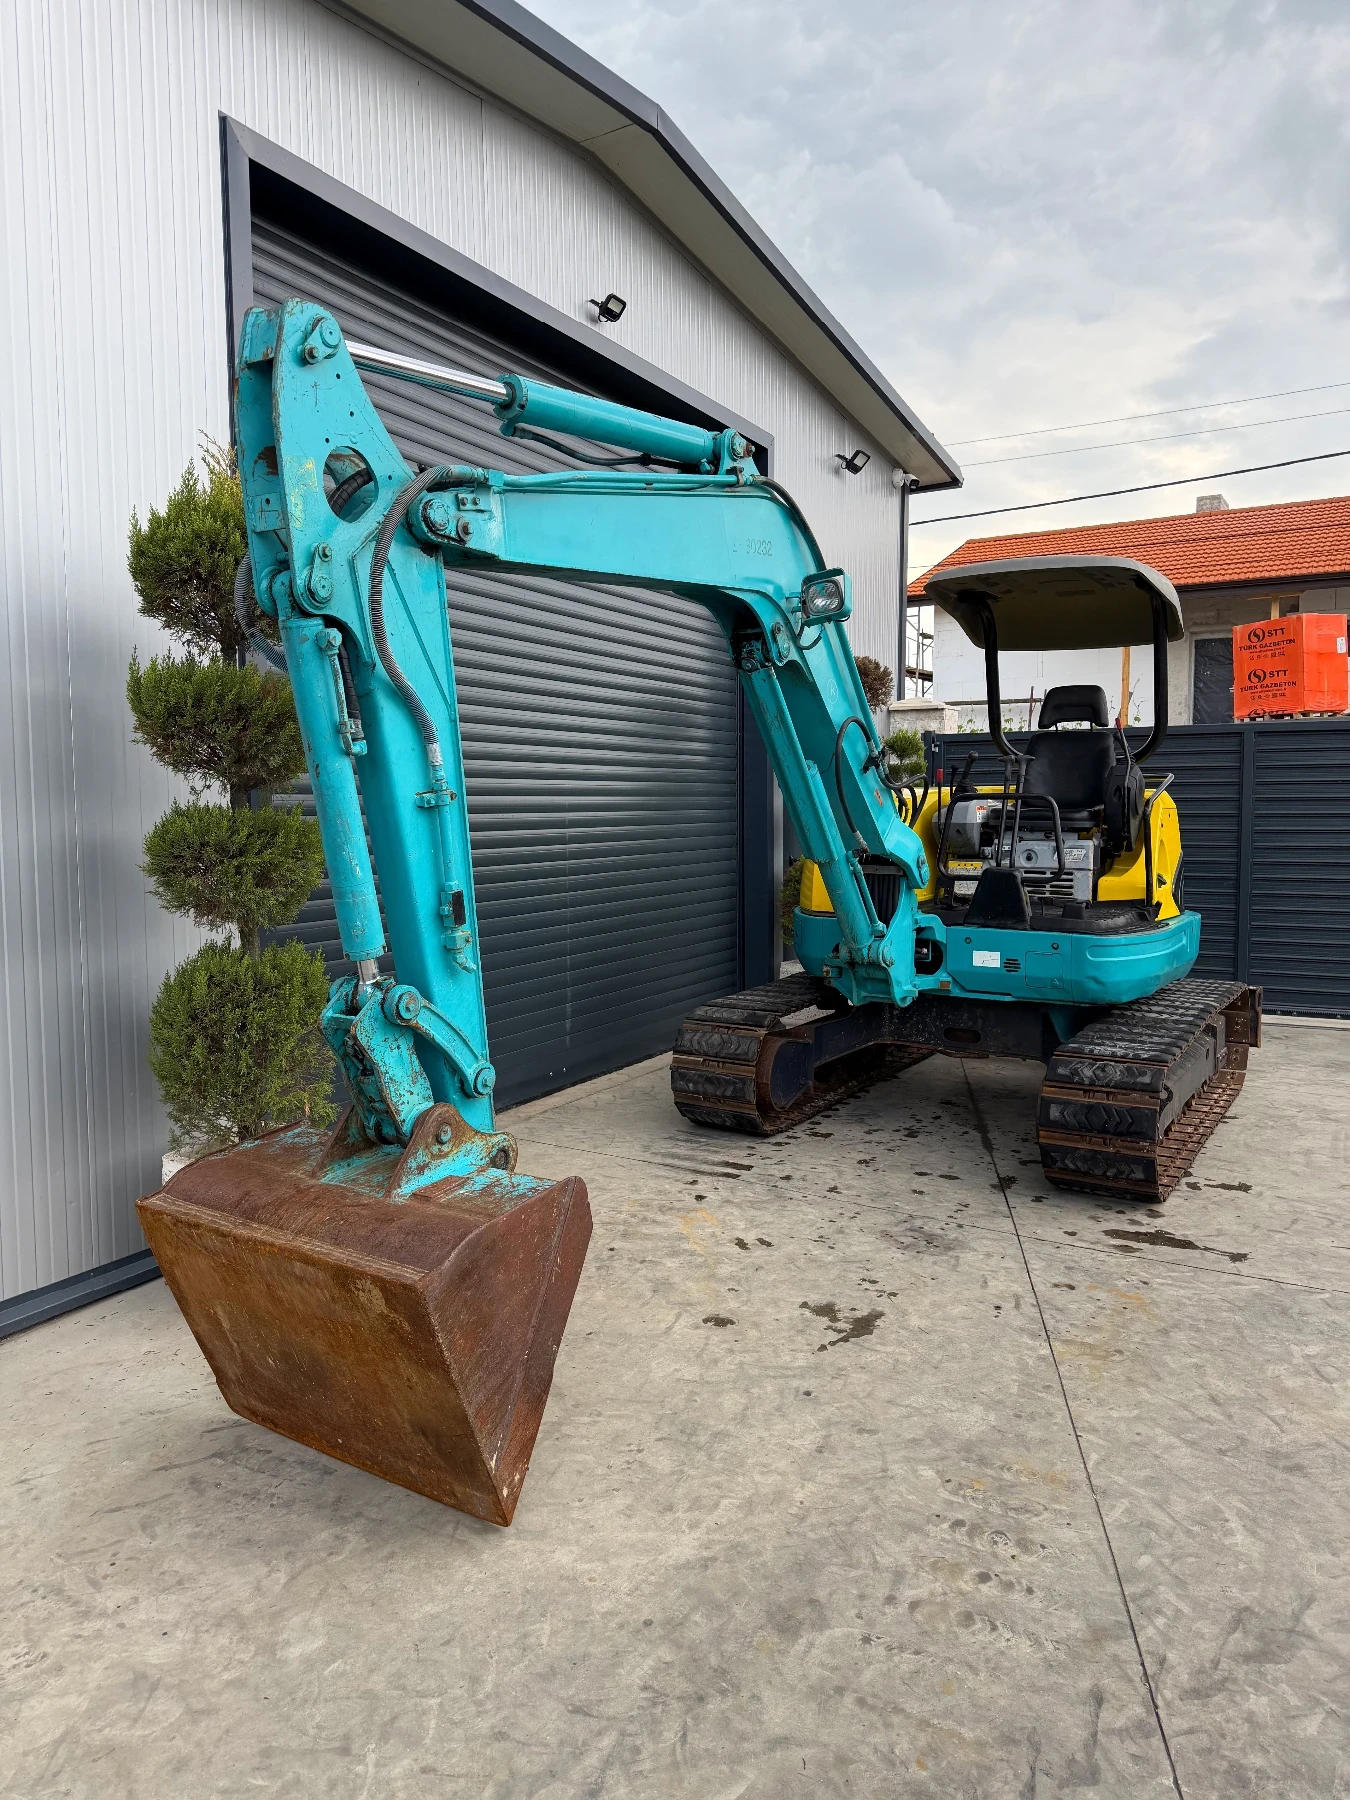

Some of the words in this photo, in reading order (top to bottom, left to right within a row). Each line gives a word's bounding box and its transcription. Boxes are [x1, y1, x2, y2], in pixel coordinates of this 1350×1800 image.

[1267, 627, 1285, 637] STT
[1259, 638, 1295, 649] GAZBETON
[1268, 669, 1288, 678] STT
[1260, 681, 1296, 689] GAZBETON
